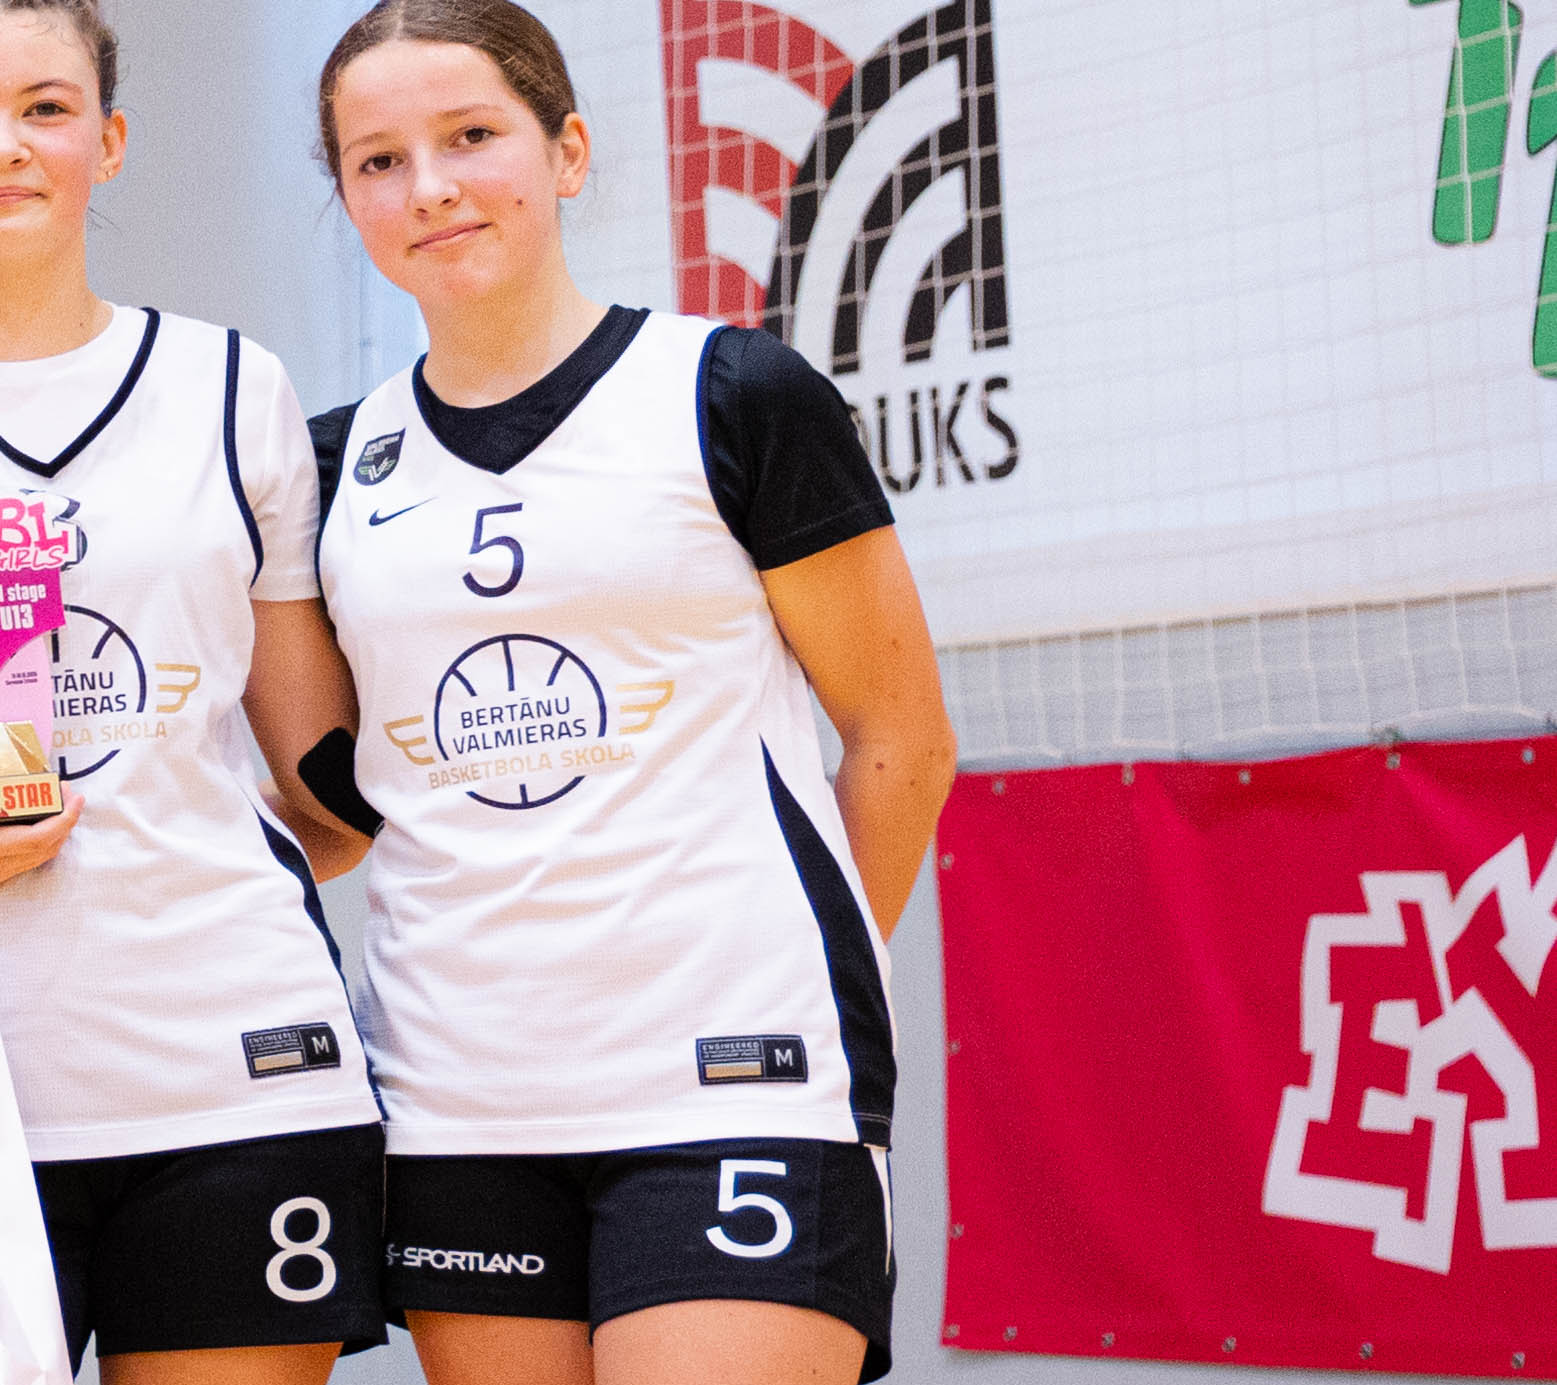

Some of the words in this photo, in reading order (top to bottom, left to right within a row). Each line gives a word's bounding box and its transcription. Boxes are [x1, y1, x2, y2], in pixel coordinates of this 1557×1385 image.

[845, 376, 1020, 494] UKS
[462, 501, 525, 598] 5
[6, 582, 47, 604] stage
[0, 605, 35, 632] U13
[460, 695, 571, 730] BERTĀNU
[100, 720, 168, 743] SKOLA
[452, 718, 588, 755] VALMIERAS
[427, 751, 553, 790] BASKETBOLA
[559, 742, 637, 768] SKOLA
[4, 781, 54, 809] STAR
[311, 1035, 330, 1055] M
[702, 1041, 760, 1051] ENGINEERED
[774, 1048, 794, 1067] M
[705, 1159, 794, 1259] 5
[265, 1196, 338, 1302] 8
[402, 1247, 545, 1275] SPORTLAND
